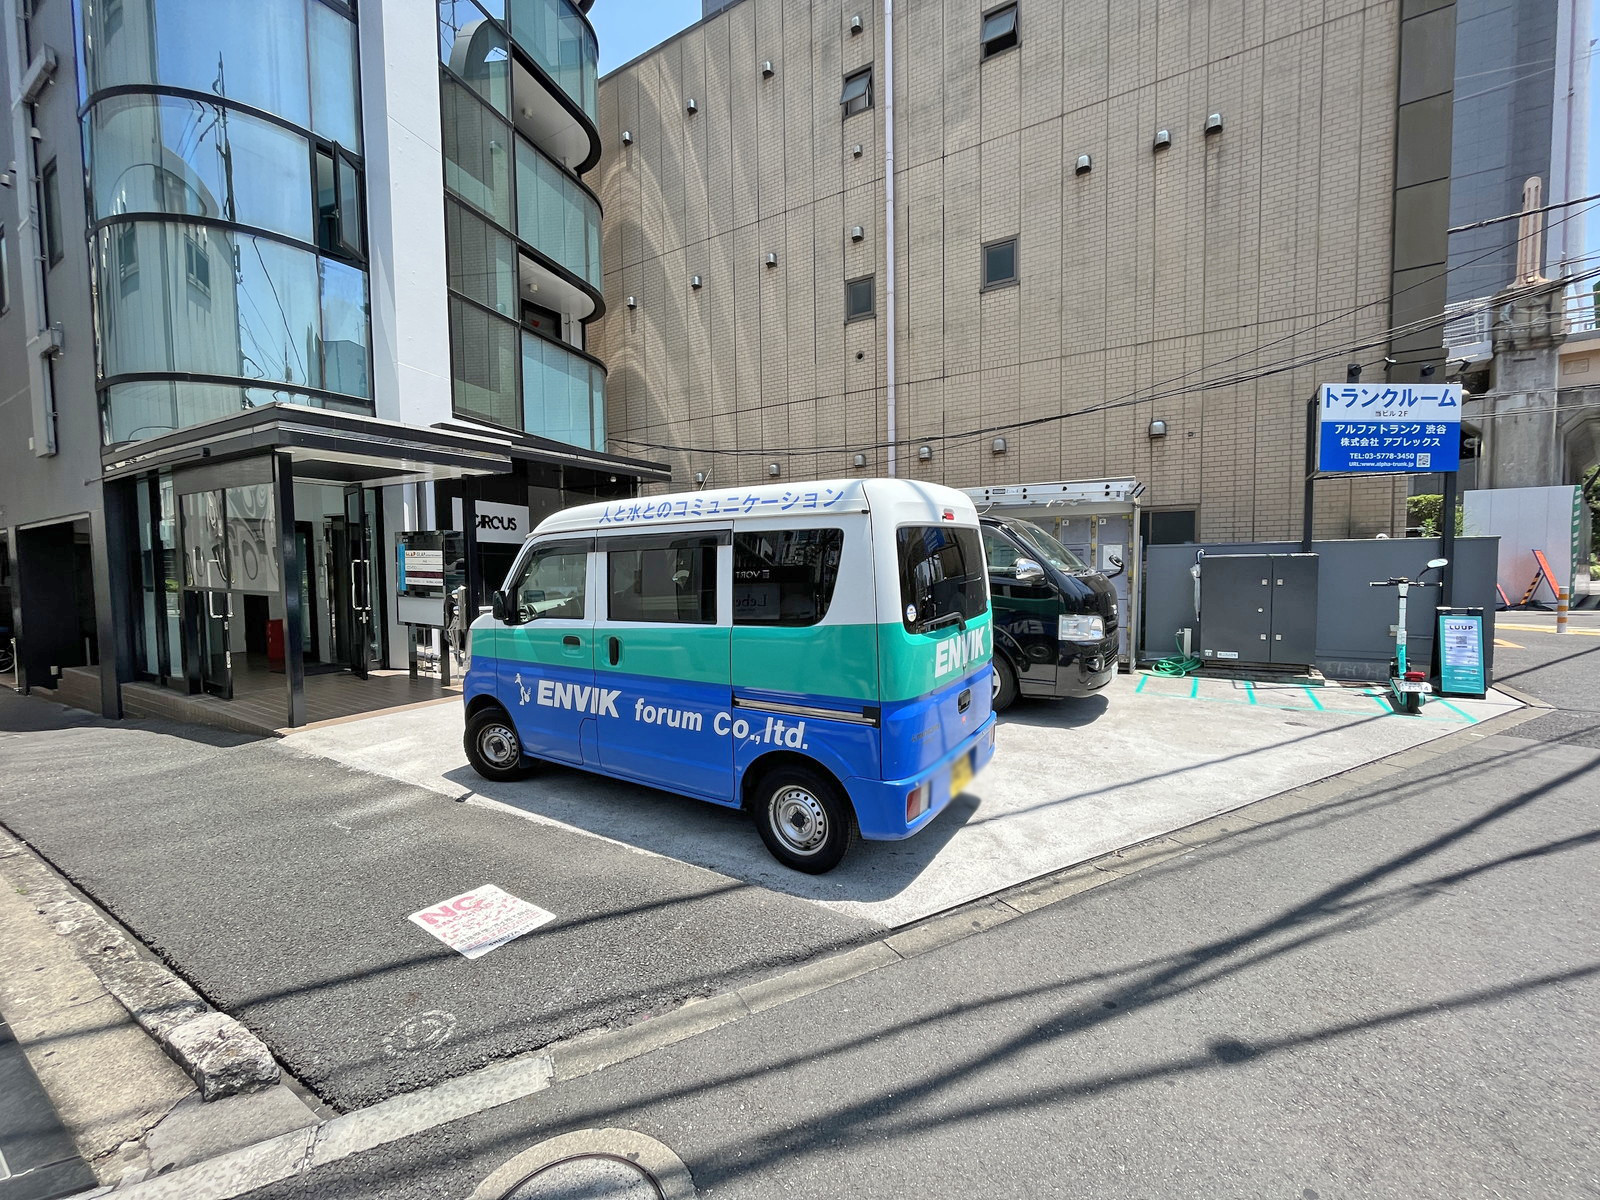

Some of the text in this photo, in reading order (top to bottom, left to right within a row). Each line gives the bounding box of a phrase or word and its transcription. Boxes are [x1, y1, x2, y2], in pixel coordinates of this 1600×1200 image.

[1326, 387, 1457, 409] トランクルーム
[1335, 424, 1447, 434] アルファトランク 渋谷
[1340, 437, 1379, 447] 株式会社
[1349, 452, 1415, 460] TEL:03-5778-3450
[599, 488, 844, 524] 人と水とのコミュニケーション
[935, 626, 985, 678] ENVIK
[537, 680, 809, 750] ENVIK forum Co.,ltd.
